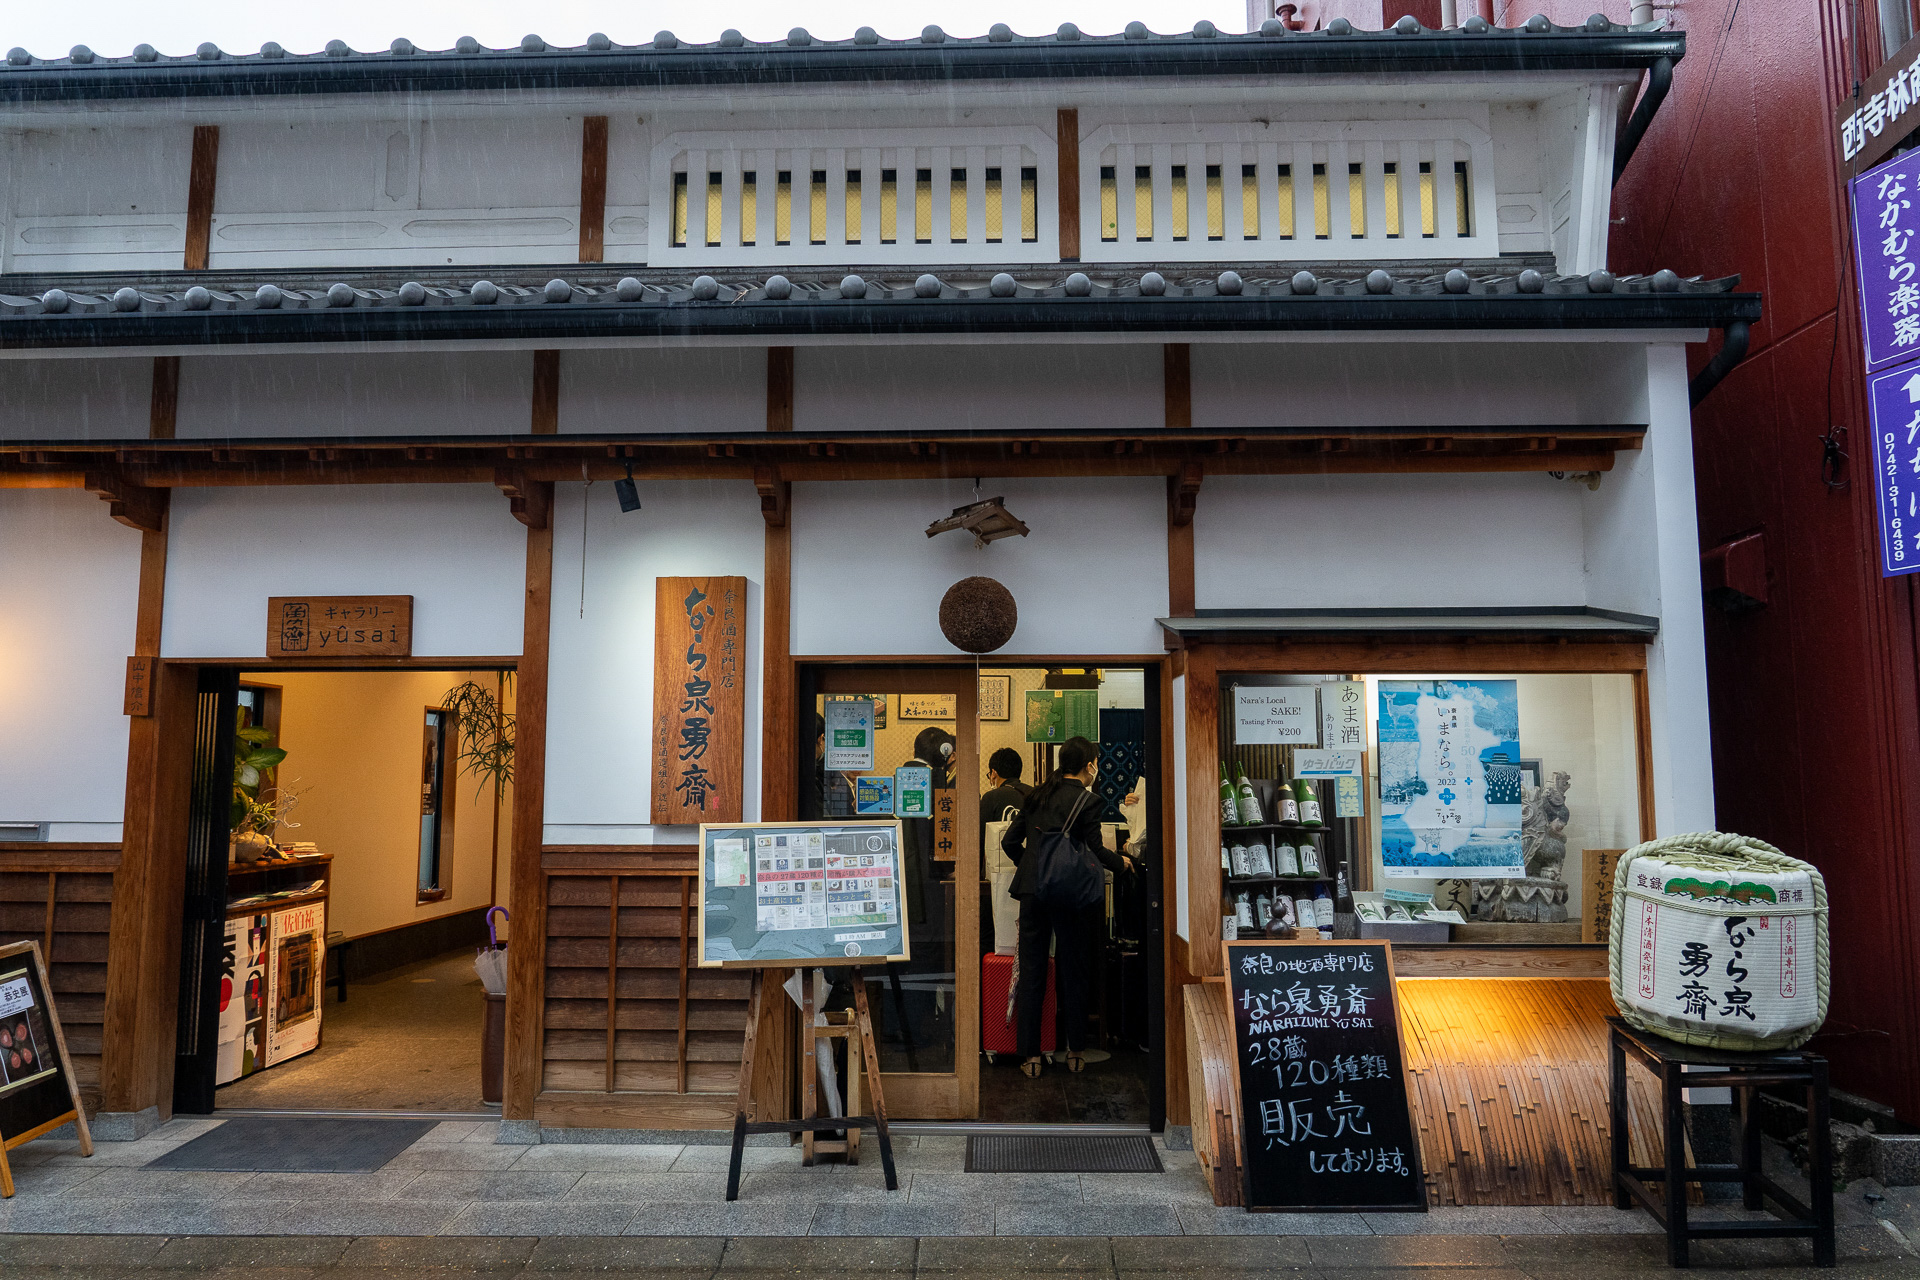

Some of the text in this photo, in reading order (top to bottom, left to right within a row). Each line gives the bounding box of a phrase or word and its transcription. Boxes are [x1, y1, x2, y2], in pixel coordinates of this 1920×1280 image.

[1878, 173, 1920, 347] なかむら楽器
[325, 606, 394, 619] ギャラリー
[319, 624, 399, 648] yûsai
[1240, 696, 1287, 704] Nara's Local
[1270, 707, 1302, 716] SAKE!
[1341, 685, 1360, 743] あま酒
[1240, 718, 1266, 726] Tasting
[1278, 727, 1302, 736] ¥200
[1325, 713, 1336, 749] あります
[1437, 707, 1454, 776] いまなら。
[1302, 757, 1357, 770] ゆうパック
[1338, 776, 1360, 817] 発送
[1437, 778, 1457, 786] 2022
[938, 796, 954, 853] 営業中
[1636, 873, 1804, 903] 登録 商標
[284, 908, 322, 935] 佐伯祐三
[1240, 951, 1374, 976] 奈良の地酒専門店
[1641, 903, 1654, 994] 日本清酒発祥の地
[1718, 916, 1756, 1021] なら泉
[1248, 1016, 1331, 1036] NARAIZUMI
[1248, 1034, 1308, 1066] 28蔵
[1272, 1053, 1391, 1090] 120種類
[1260, 1090, 1372, 1151] 販売
[1309, 1146, 1409, 1177] しております。
